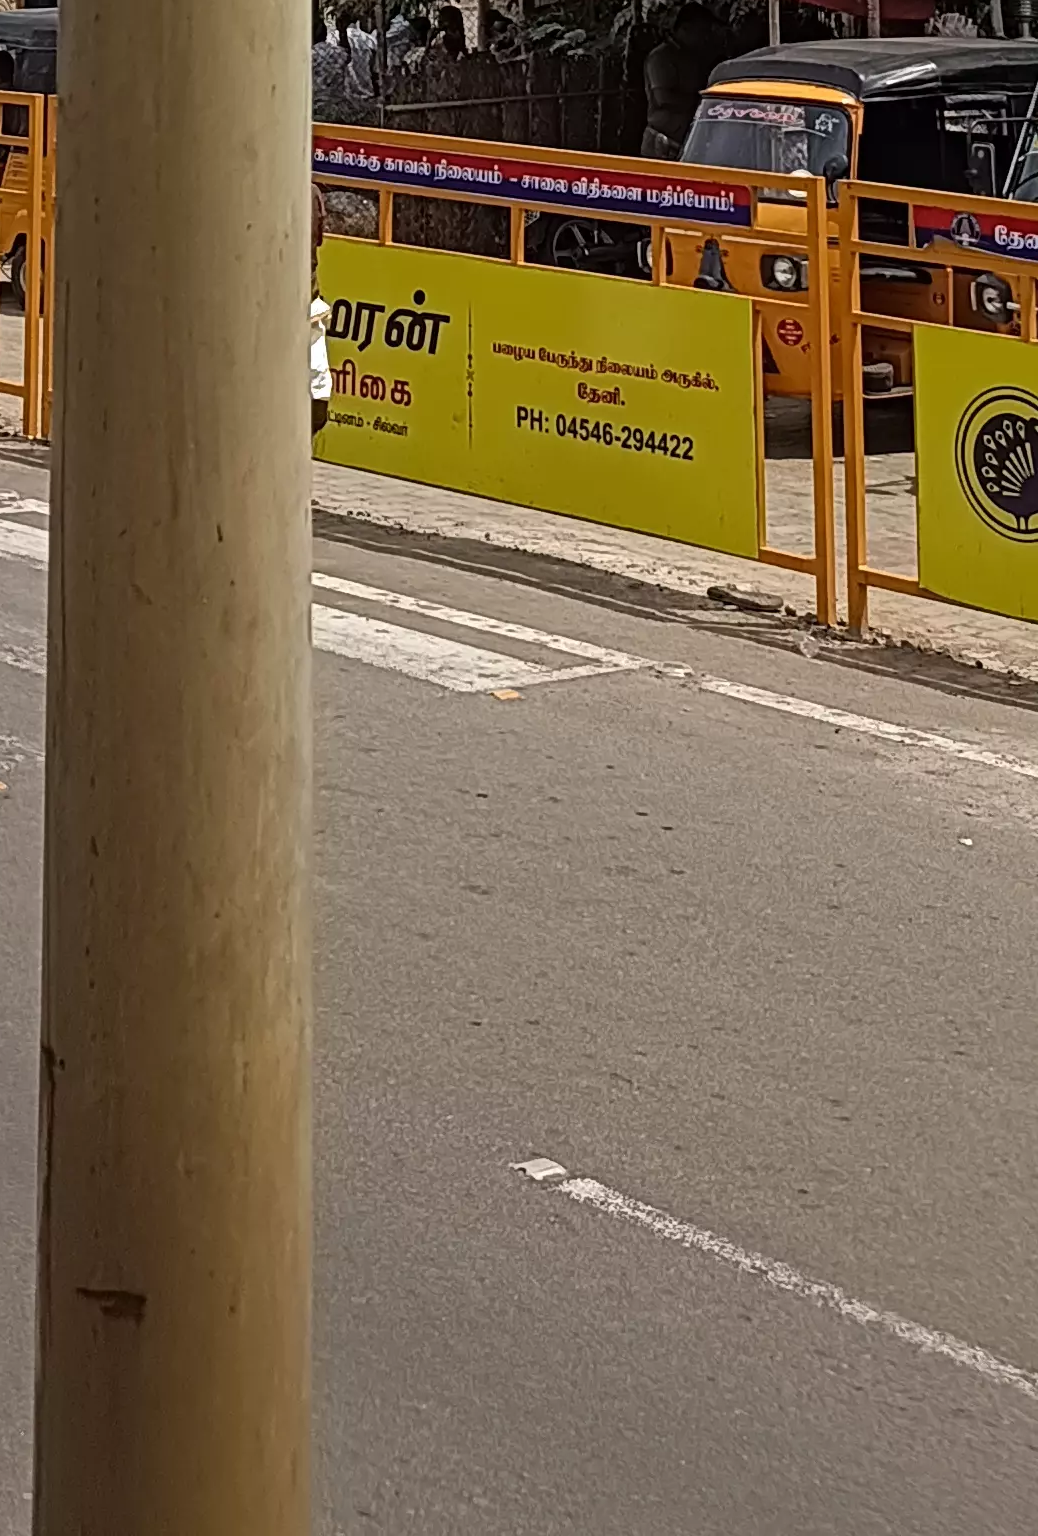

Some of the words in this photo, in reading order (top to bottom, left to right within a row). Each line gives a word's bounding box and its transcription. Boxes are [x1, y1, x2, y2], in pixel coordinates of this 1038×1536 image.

[384, 156, 432, 176] காவல்
[433, 159, 503, 185] நிலையம்
[521, 175, 568, 193] சாலை
[572, 177, 642, 202] விதிகளை
[646, 185, 735, 212] மதிப்போம்!
[326, 289, 450, 355] மரன்
[493, 342, 535, 361] பழைய
[539, 347, 593, 373] பேருந்து
[595, 357, 658, 380] நிலையம்
[578, 383, 625, 406] தேனி.
[517, 406, 549, 433] PH:
[556, 414, 694, 461] 04546-294422
